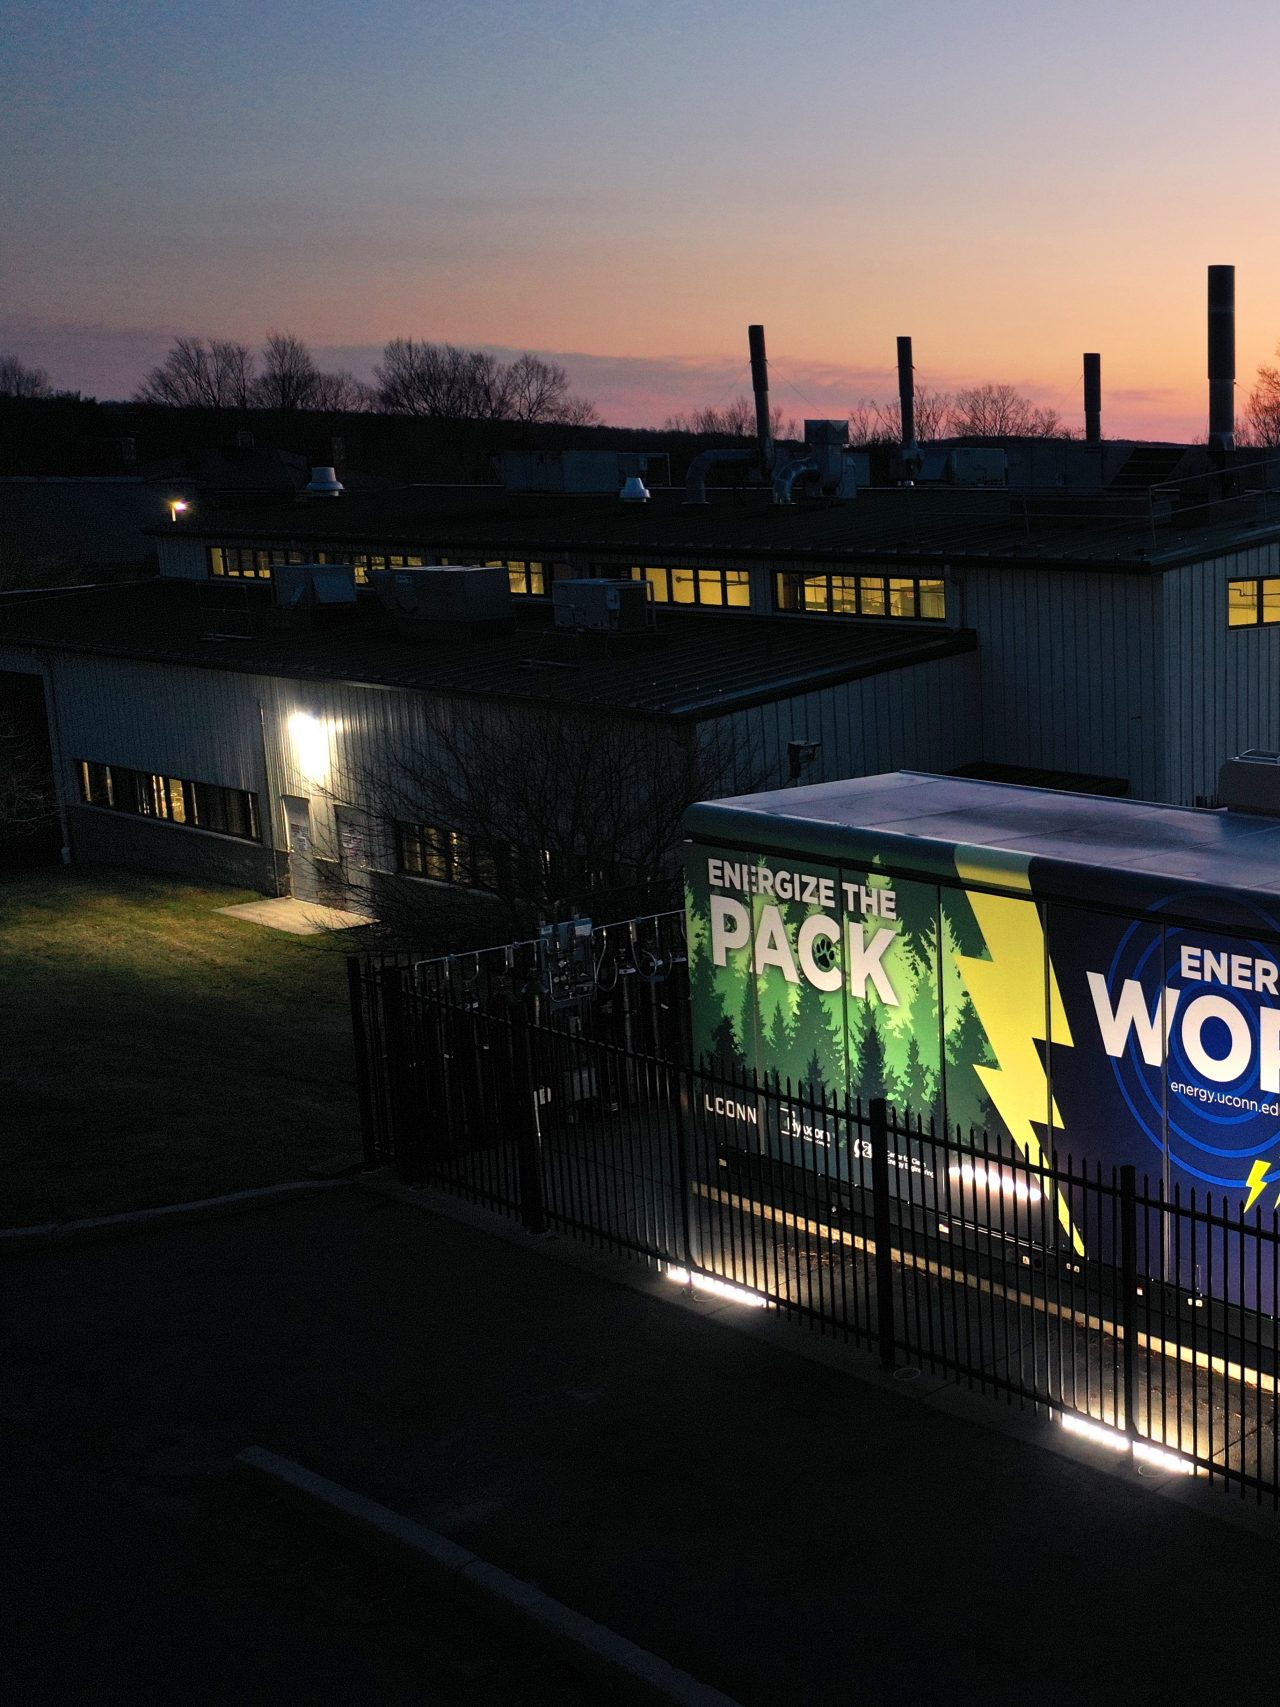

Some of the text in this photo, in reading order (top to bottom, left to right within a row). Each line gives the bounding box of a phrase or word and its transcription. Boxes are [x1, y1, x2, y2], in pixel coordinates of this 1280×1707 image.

[708, 858, 897, 920] ENERGIZE THE
[710, 894, 900, 1007] PACK
